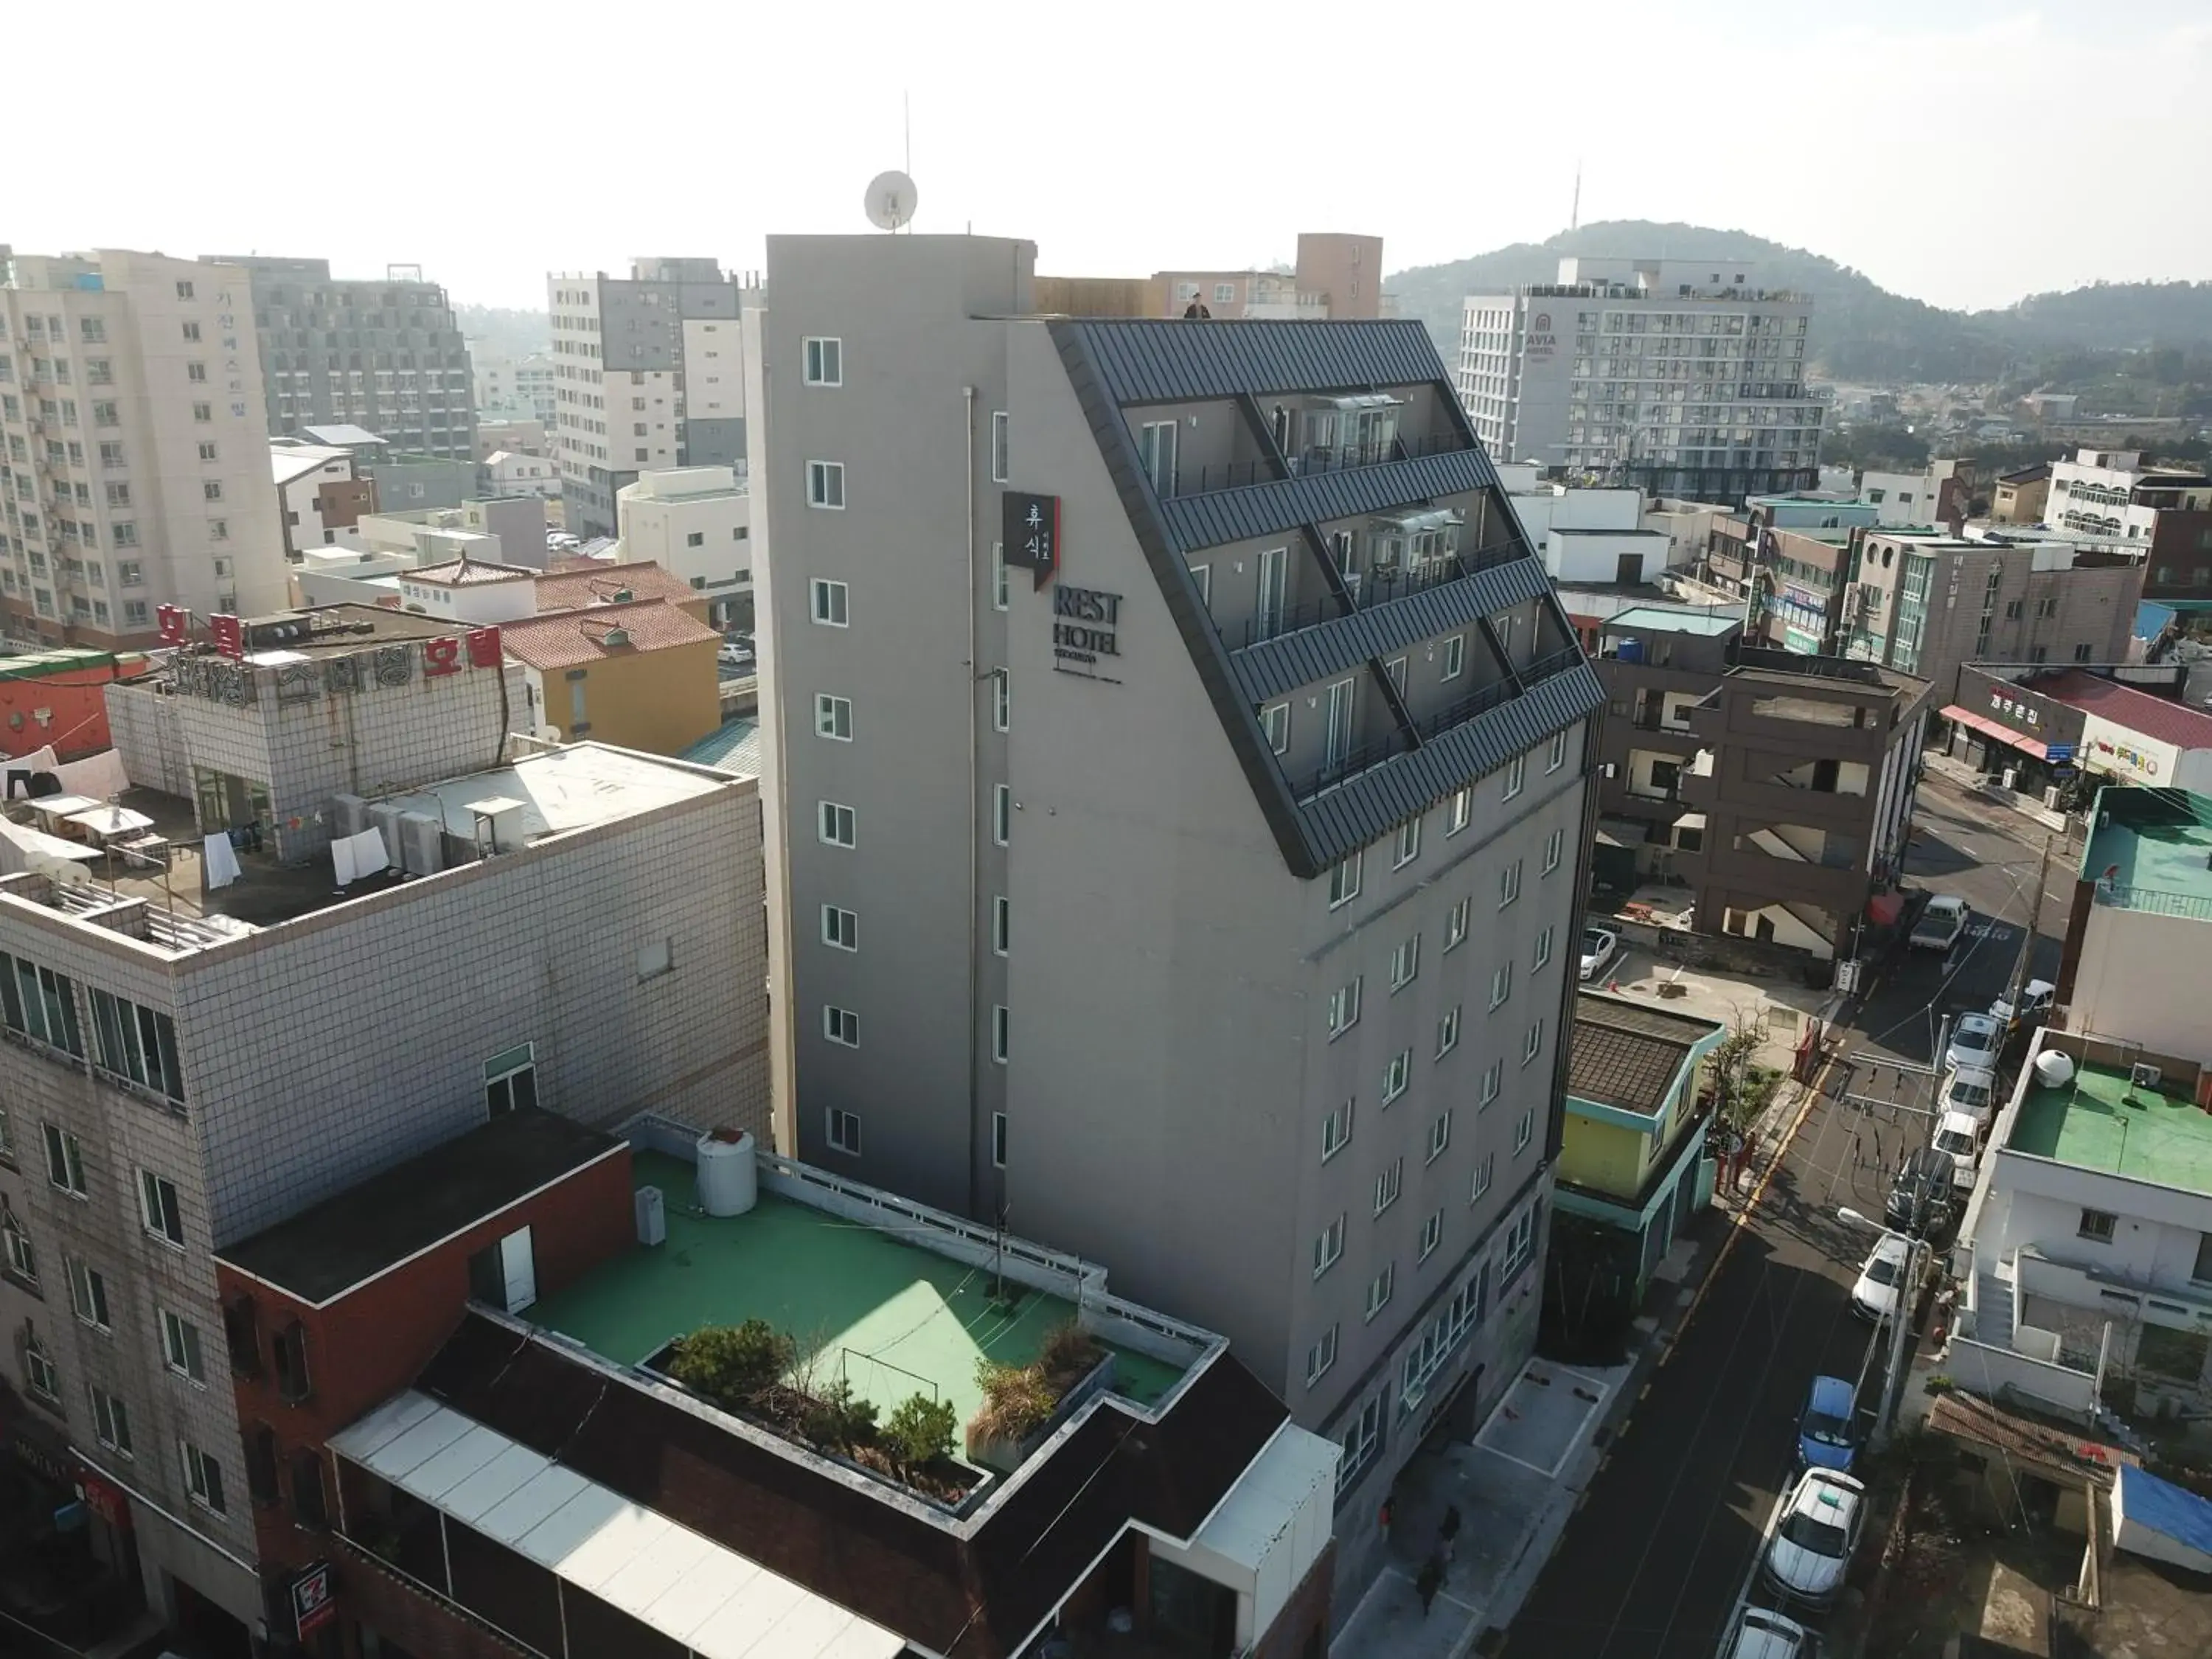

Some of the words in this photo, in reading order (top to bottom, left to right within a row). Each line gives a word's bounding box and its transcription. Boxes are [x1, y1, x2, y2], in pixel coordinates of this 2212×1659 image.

[1527, 334, 1556, 344] AVIA
[1025, 503, 1044, 559] 휴식
[1054, 585, 1123, 624] REST
[1053, 623, 1121, 655] HOTEL
